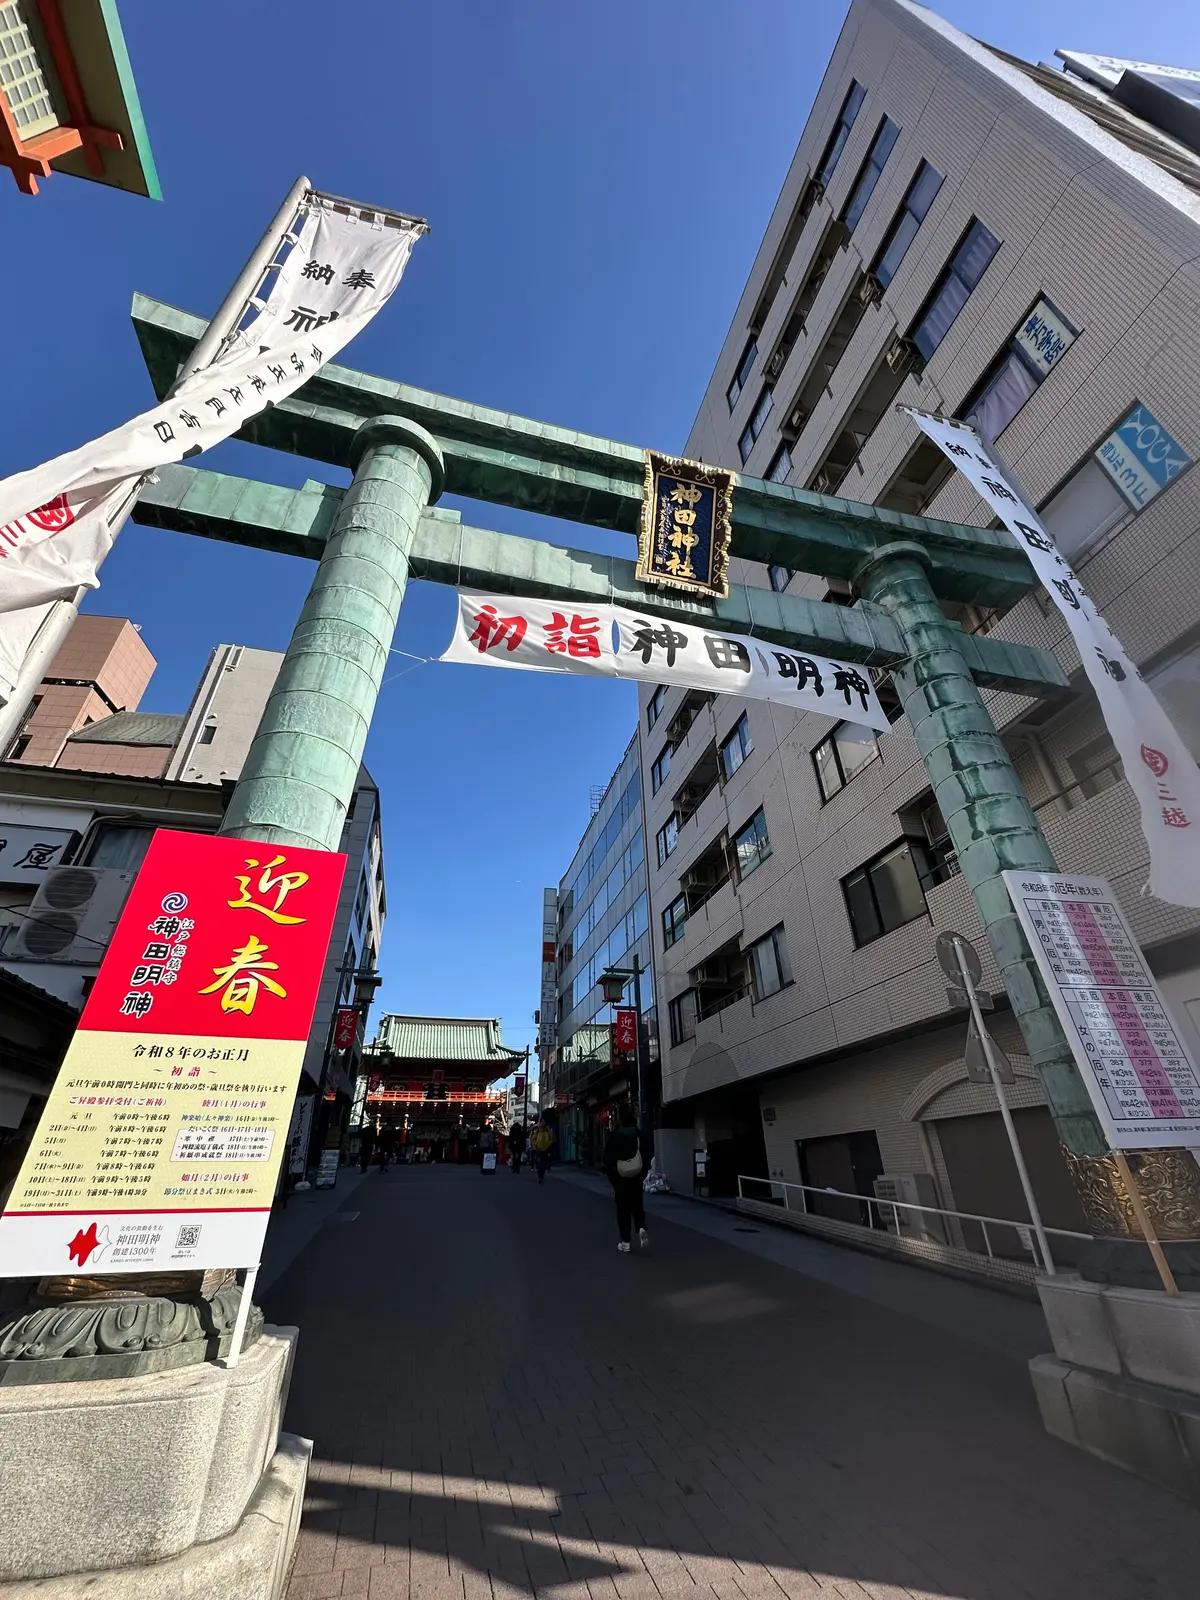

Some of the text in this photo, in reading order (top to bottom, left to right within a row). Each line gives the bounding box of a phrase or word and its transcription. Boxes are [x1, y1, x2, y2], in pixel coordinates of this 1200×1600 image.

[1120, 407, 1189, 481] YOGA
[666, 482, 703, 578] 神田神社
[468, 605, 868, 712] 初詣 神田明神
[1040, 901, 1060, 910] 前厄
[1066, 903, 1086, 911] 本厄
[1092, 904, 1112, 913] 後厄
[198, 855, 310, 1016] 迎春
[1034, 919, 1063, 973] 男の厄年
[120, 916, 180, 1019] 神田明神
[1078, 991, 1099, 1000] 前厄
[1106, 992, 1127, 1000] 本厄
[1133, 993, 1153, 1001] 後厄
[620, 1016, 634, 1044] 迎春
[133, 1044, 250, 1062] 令和8年のお正月
[1078, 1025, 1111, 1088] 女の厄年
[116, 1233, 160, 1245] 神田明神
[112, 1247, 156, 1256] 創建1300年
